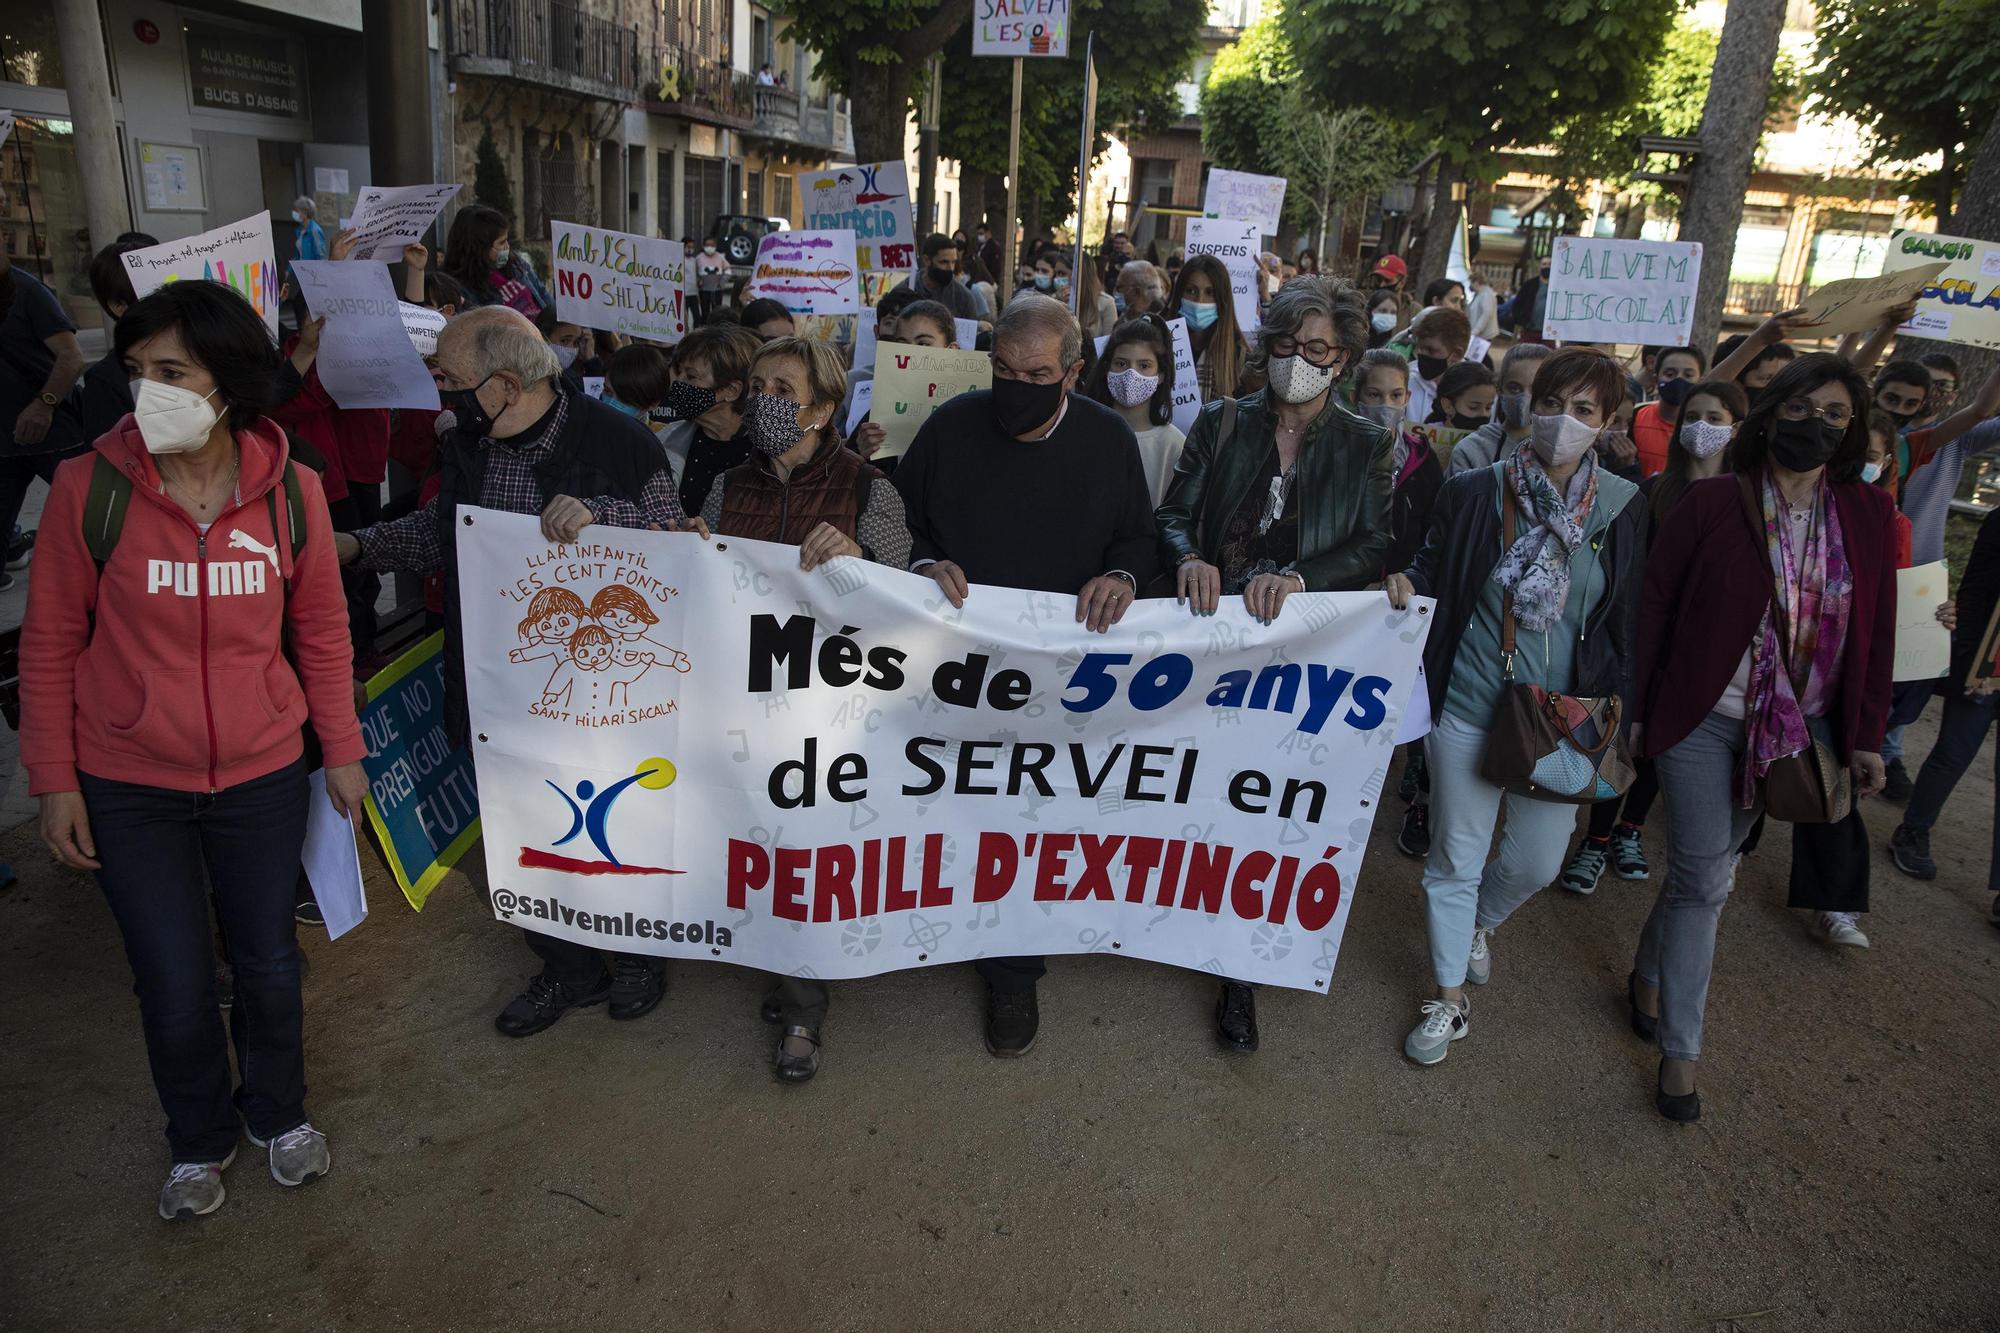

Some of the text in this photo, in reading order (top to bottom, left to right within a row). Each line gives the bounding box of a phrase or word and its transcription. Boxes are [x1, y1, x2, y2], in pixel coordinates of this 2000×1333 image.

[980, 0, 1066, 20] SALVEM
[983, 19, 1065, 43] L'ESCOLA
[201, 47, 233, 66] AULA
[234, 54, 252, 69] DE
[204, 87, 299, 113] BUCS D'ASSAIG
[557, 231, 600, 265] Amb
[1188, 243, 1248, 257] SUSPENS
[1558, 246, 1689, 283] SALVEM
[558, 268, 593, 300] NO
[601, 277, 634, 309] S'HI
[1547, 290, 1691, 325] L'ESCOLA!
[928, 383, 957, 398] PER
[1179, 381, 1188, 389] de
[895, 402, 920, 417] UN
[526, 544, 569, 569] LLAR
[147, 559, 266, 597] PUMA
[554, 563, 608, 584] CENT
[748, 613, 1393, 735] Més de 50 anys
[361, 679, 432, 759] QUE NO
[528, 699, 678, 728] SANT HILARI SACALM
[767, 735, 1328, 824] de SERVEI en
[726, 831, 1343, 931] PERILL D'EXTINCIÓ
[493, 888, 732, 948] @salvemlescola
